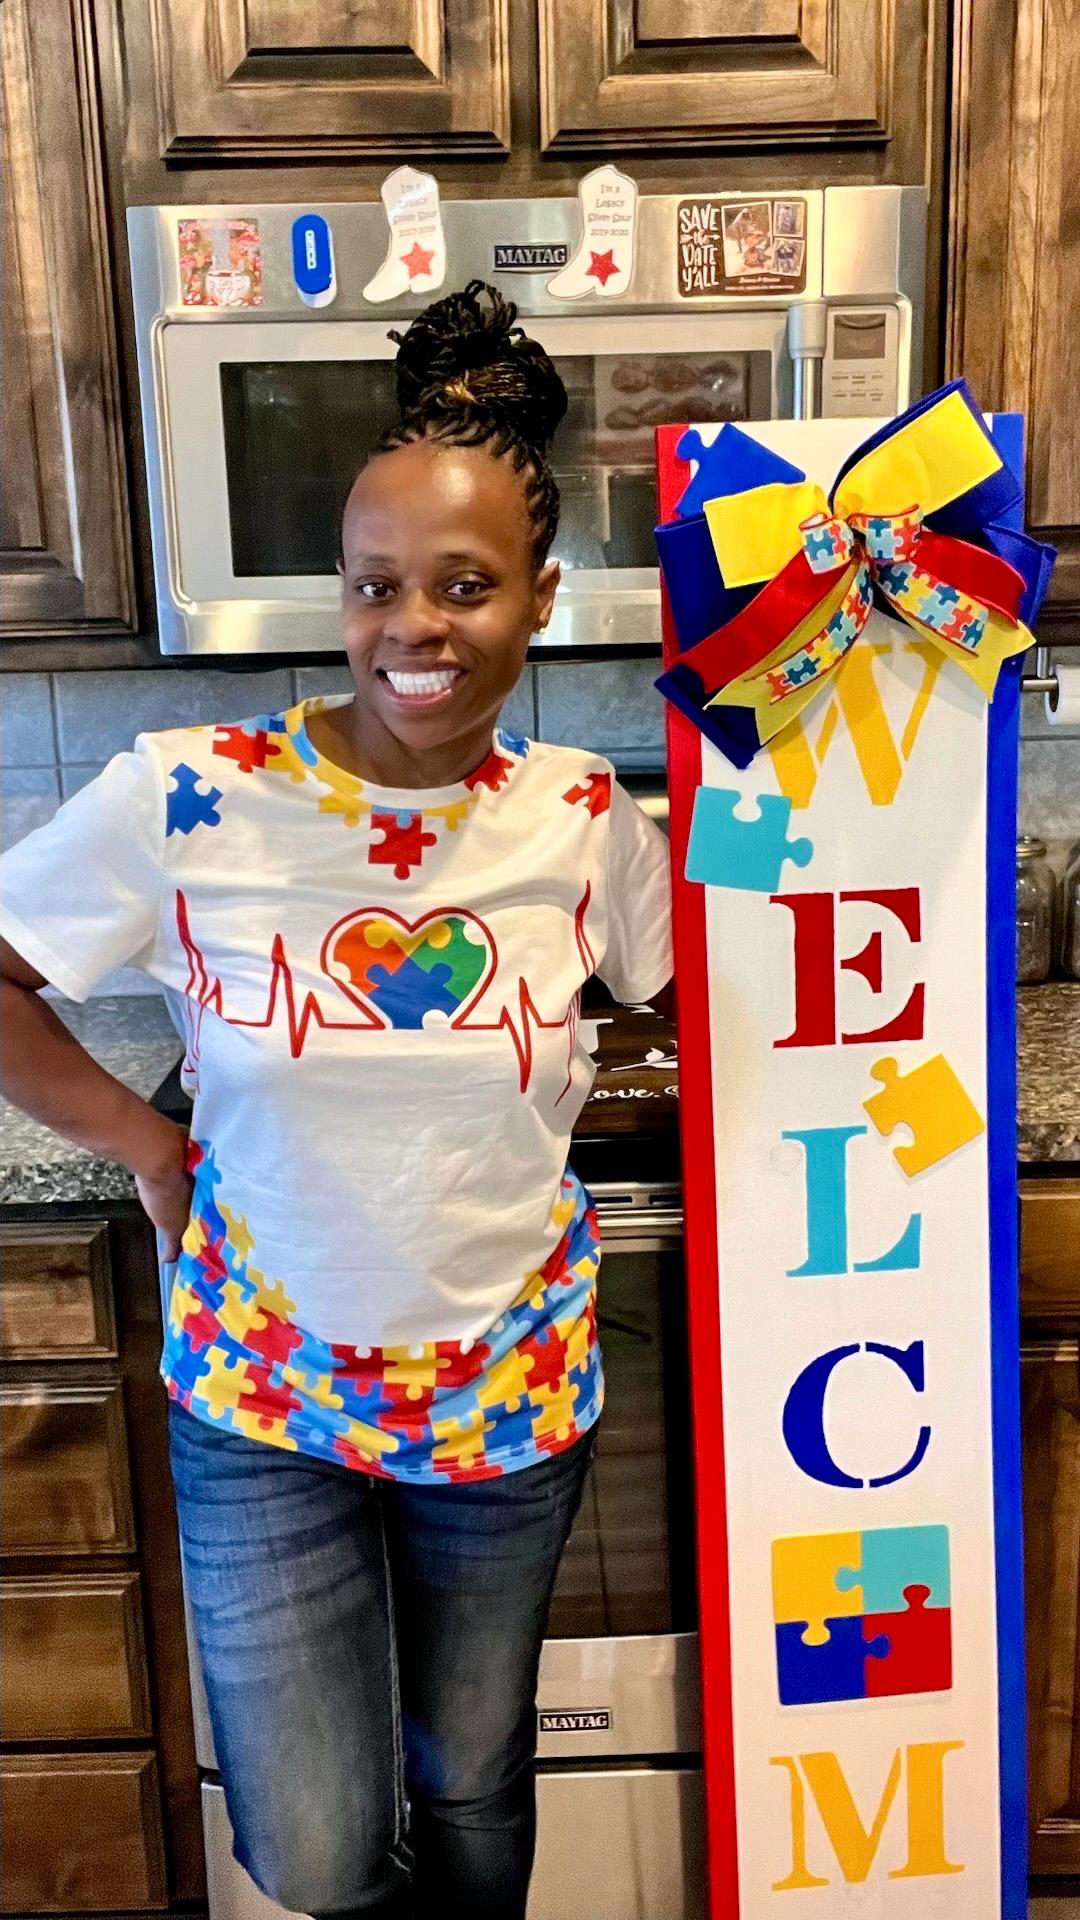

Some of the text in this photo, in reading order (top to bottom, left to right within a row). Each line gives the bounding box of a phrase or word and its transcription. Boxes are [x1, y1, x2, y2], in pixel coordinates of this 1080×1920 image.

[596, 199, 625, 209] Legacy
[679, 203, 721, 233] SAVE
[497, 248, 566, 265] MAYTAG
[682, 244, 719, 268] DATE
[682, 265, 720, 292] Y'ALL
[542, 1715, 608, 1730] MAYTAG
